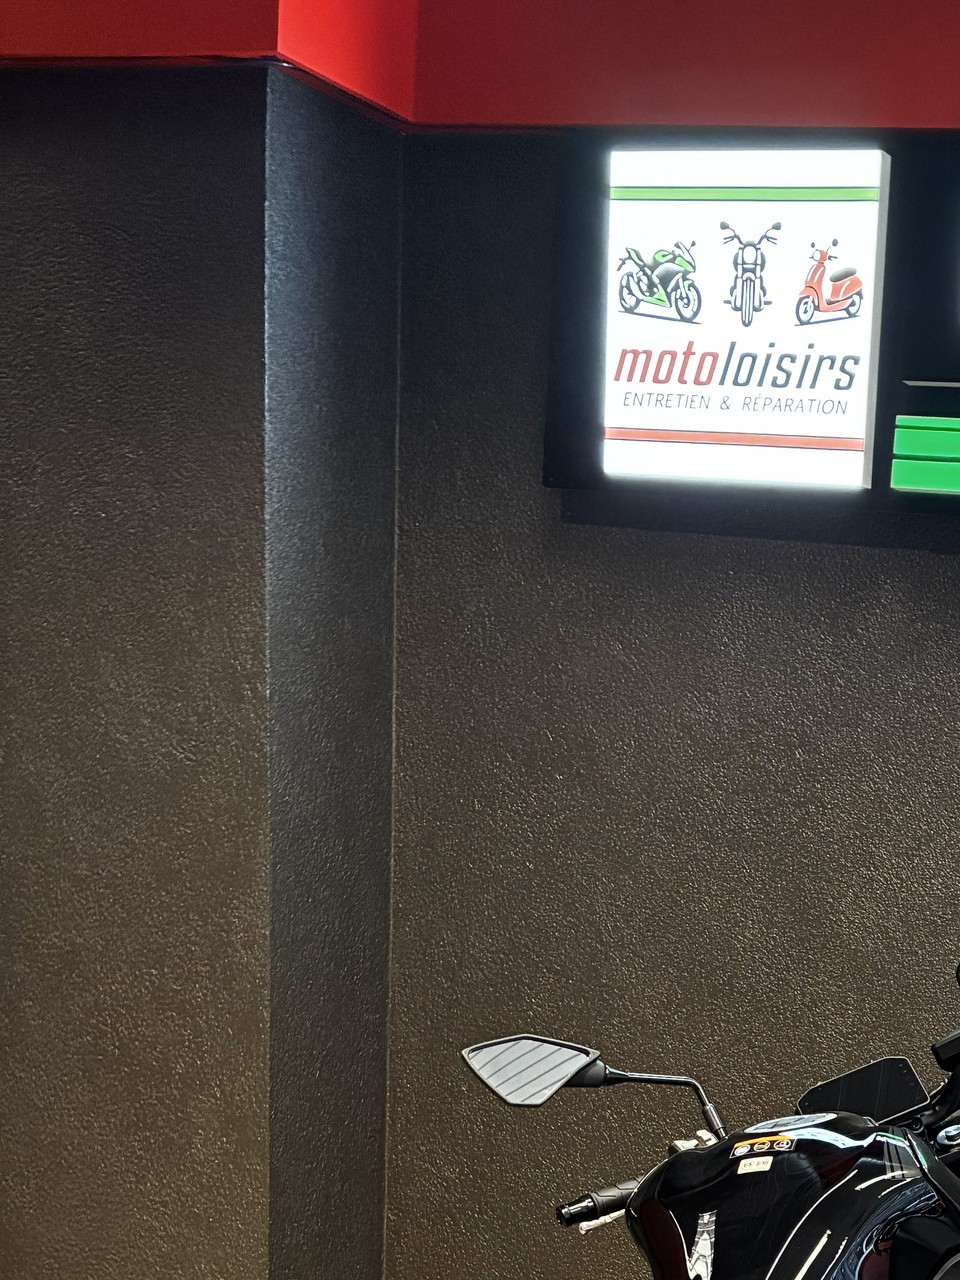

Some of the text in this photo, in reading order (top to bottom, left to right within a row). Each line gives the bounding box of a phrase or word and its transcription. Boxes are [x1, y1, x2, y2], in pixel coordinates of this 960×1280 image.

[614, 341, 861, 390] motoloisirs
[623, 392, 848, 415] ENTRETIEN & RÉPARATION
